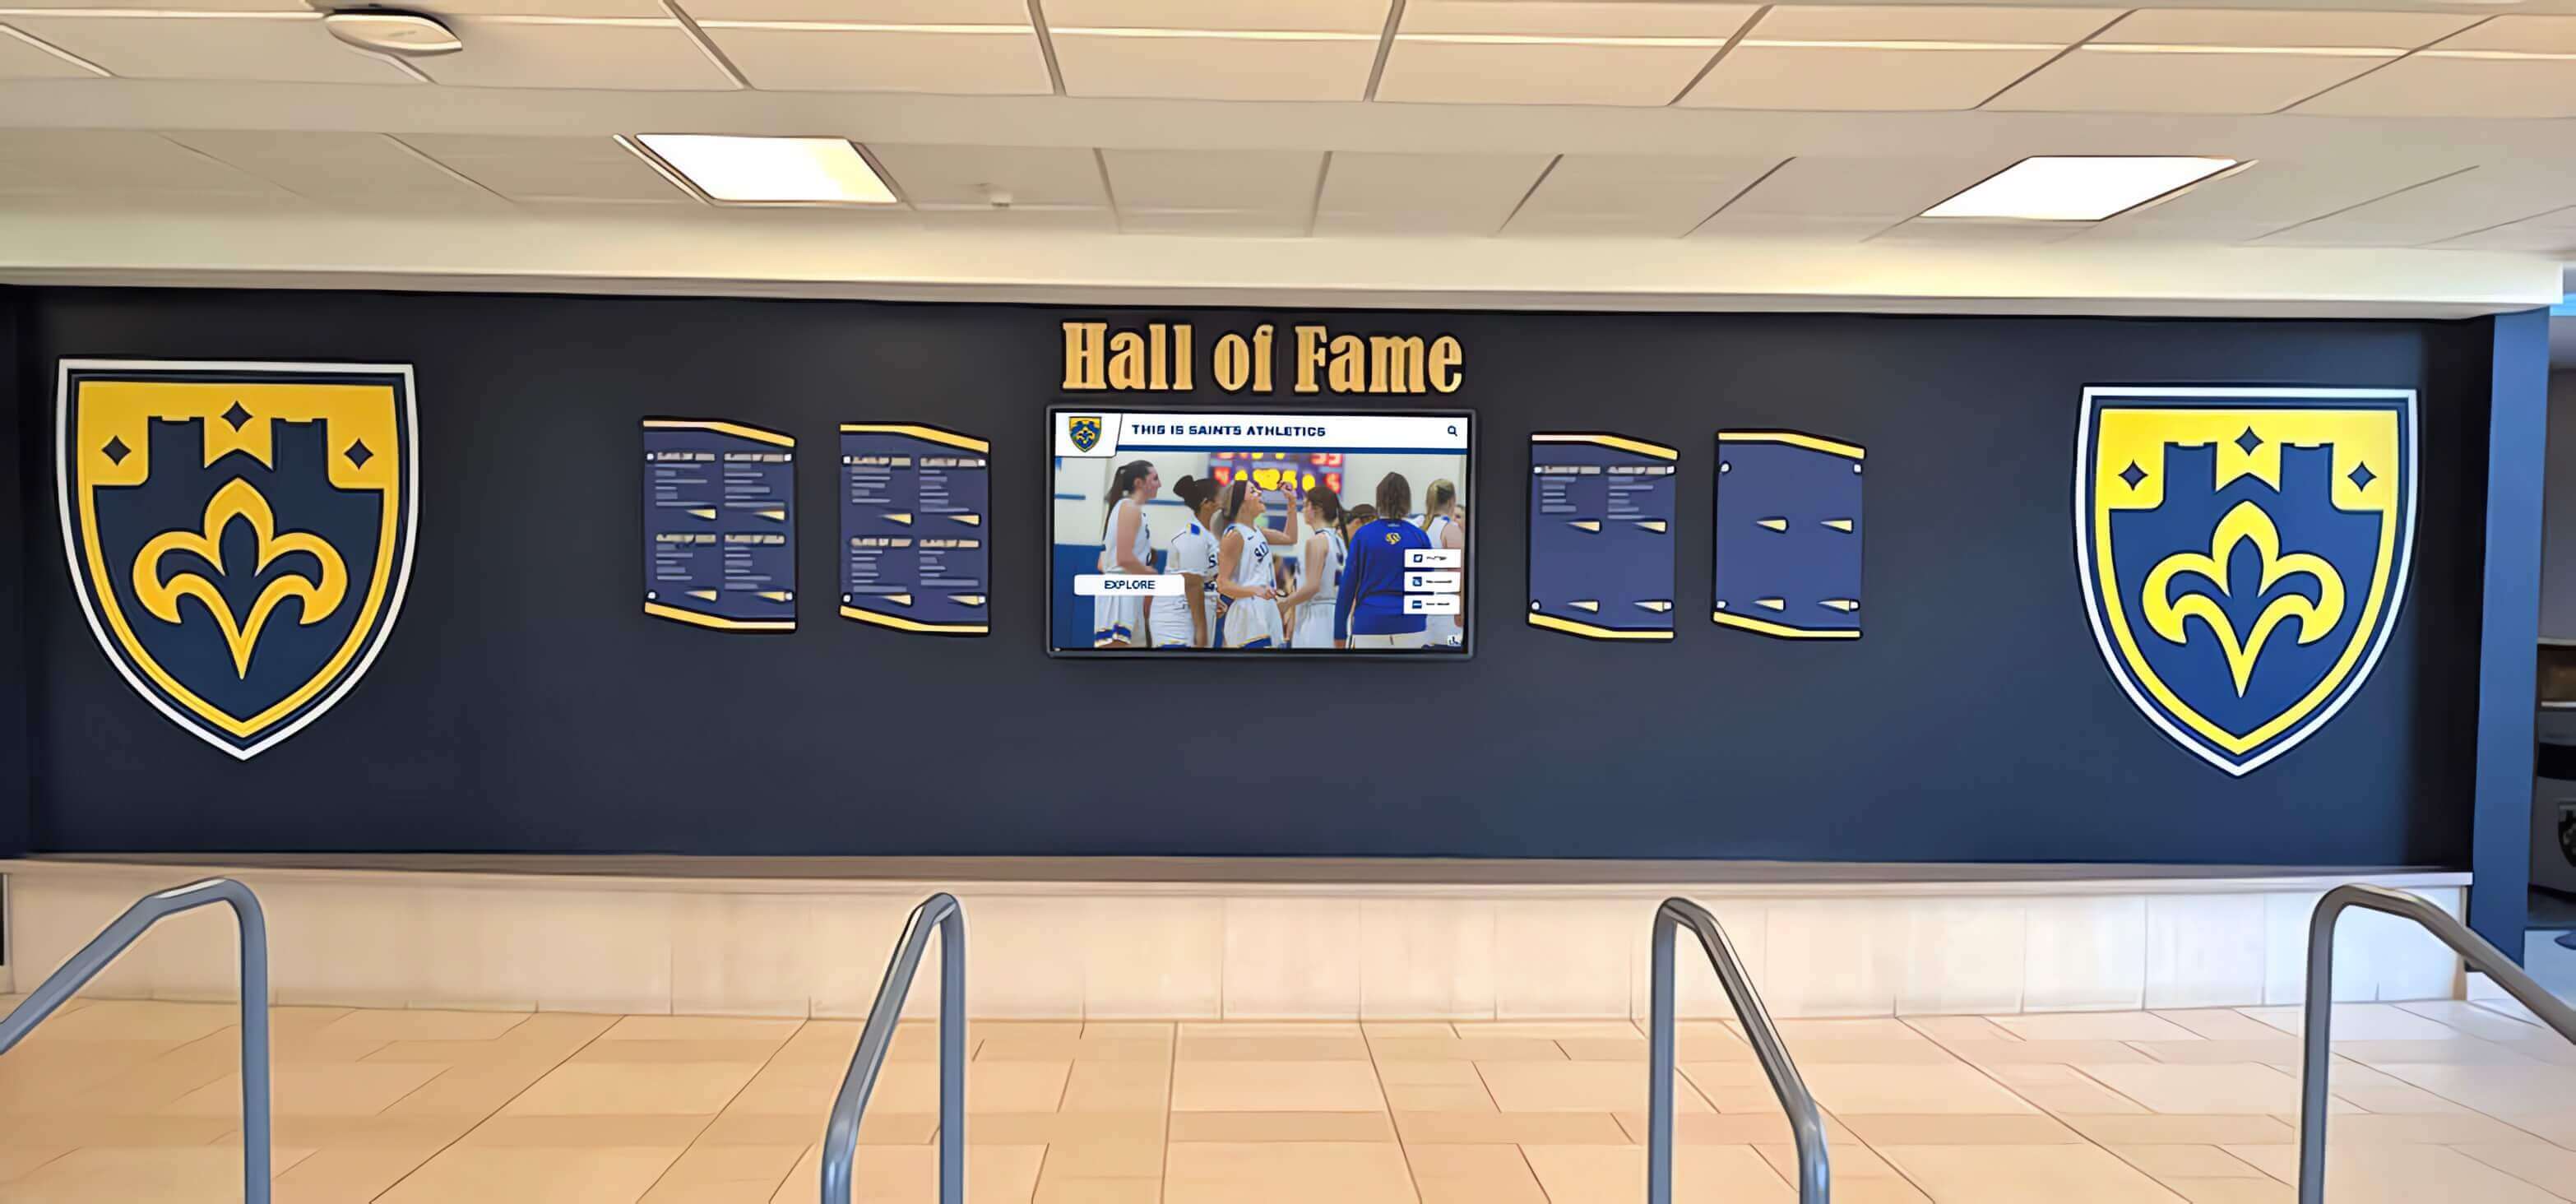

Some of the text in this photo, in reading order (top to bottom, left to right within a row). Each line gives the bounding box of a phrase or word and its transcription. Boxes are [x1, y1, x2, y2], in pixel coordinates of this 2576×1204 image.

[1062, 322, 1463, 394] Hall of Fame
[1132, 424, 1327, 437] THIS IS SAINTS ATHLETICS
[1105, 580, 1156, 590] EXPLORE
